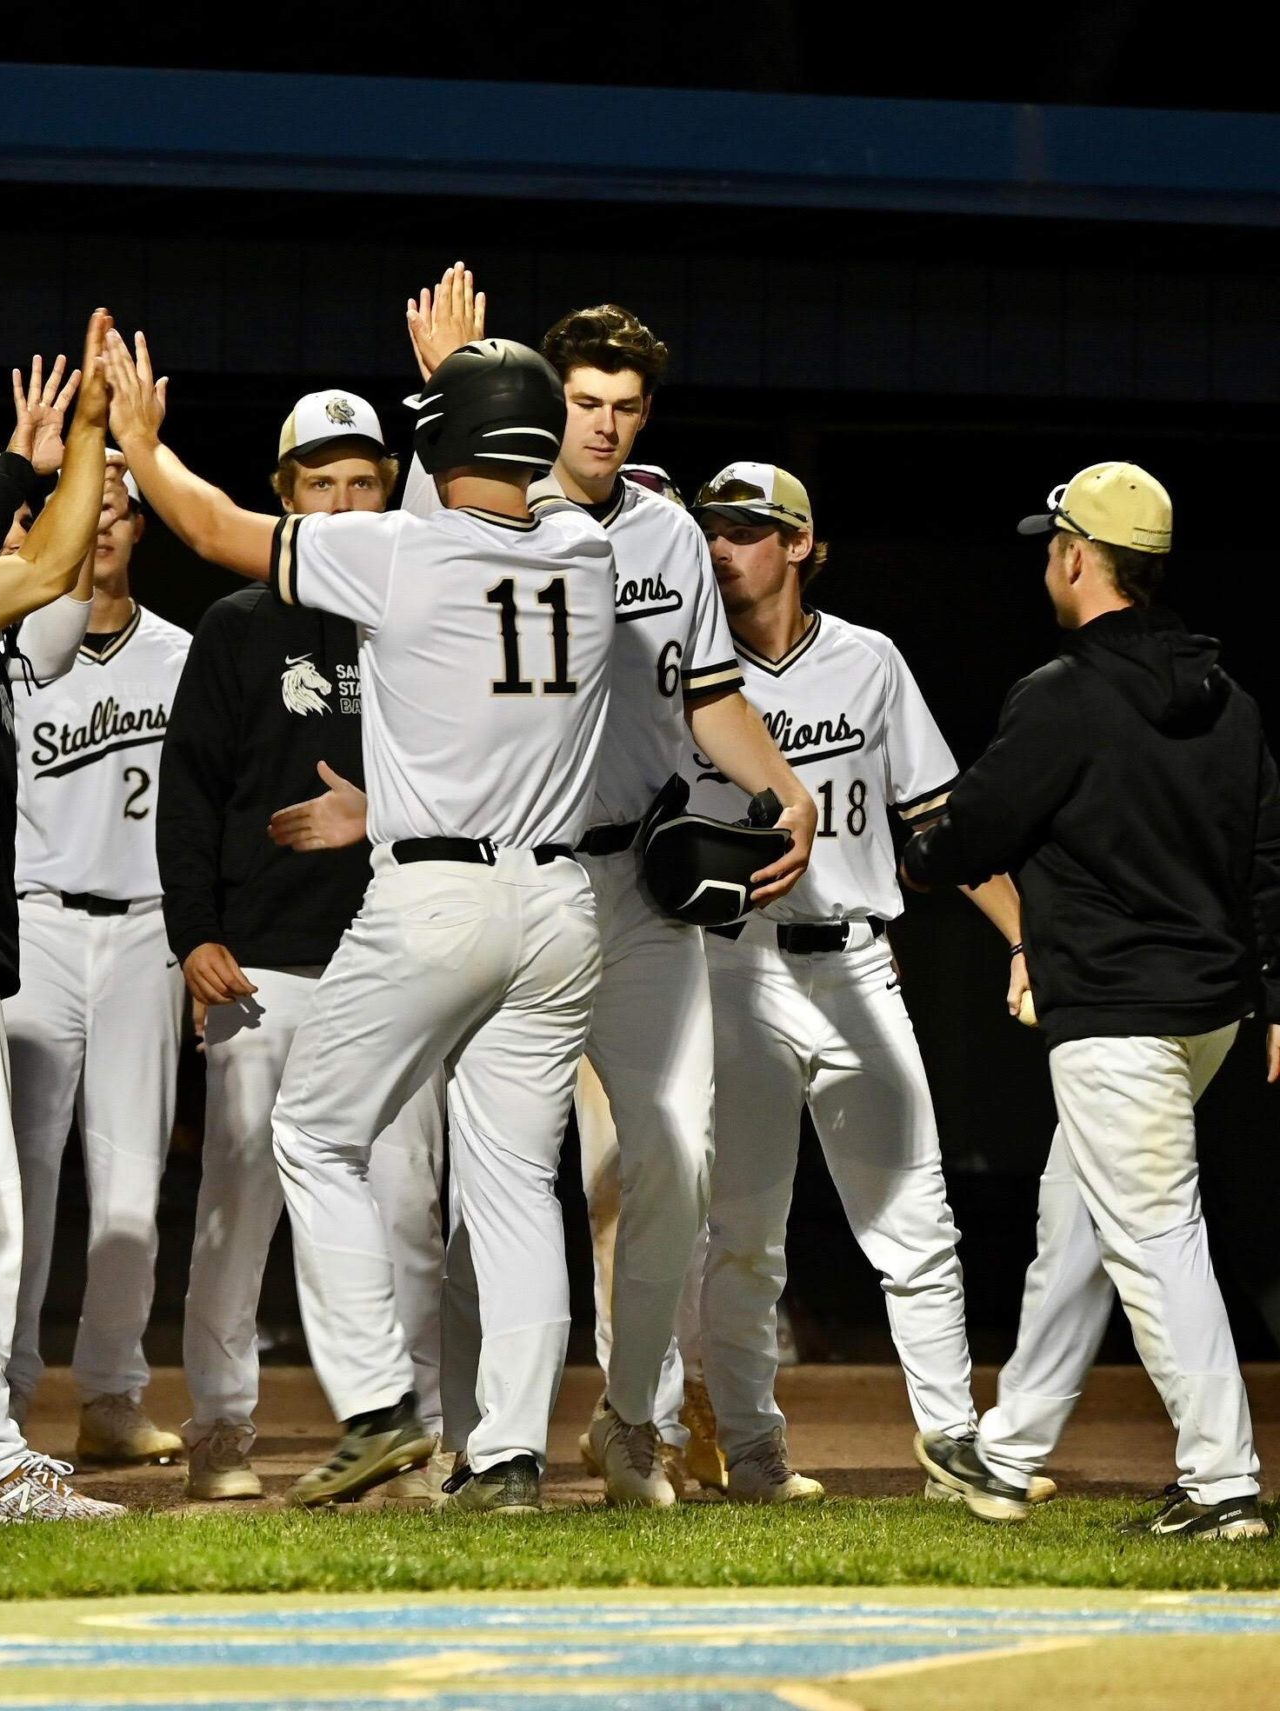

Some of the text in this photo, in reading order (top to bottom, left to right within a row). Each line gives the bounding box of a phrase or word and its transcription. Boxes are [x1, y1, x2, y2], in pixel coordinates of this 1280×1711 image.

[485, 575, 578, 697] 11
[656, 640, 683, 698] 6
[32, 696, 169, 767] Stallions
[122, 767, 151, 820] 2
[816, 779, 868, 838] 18
